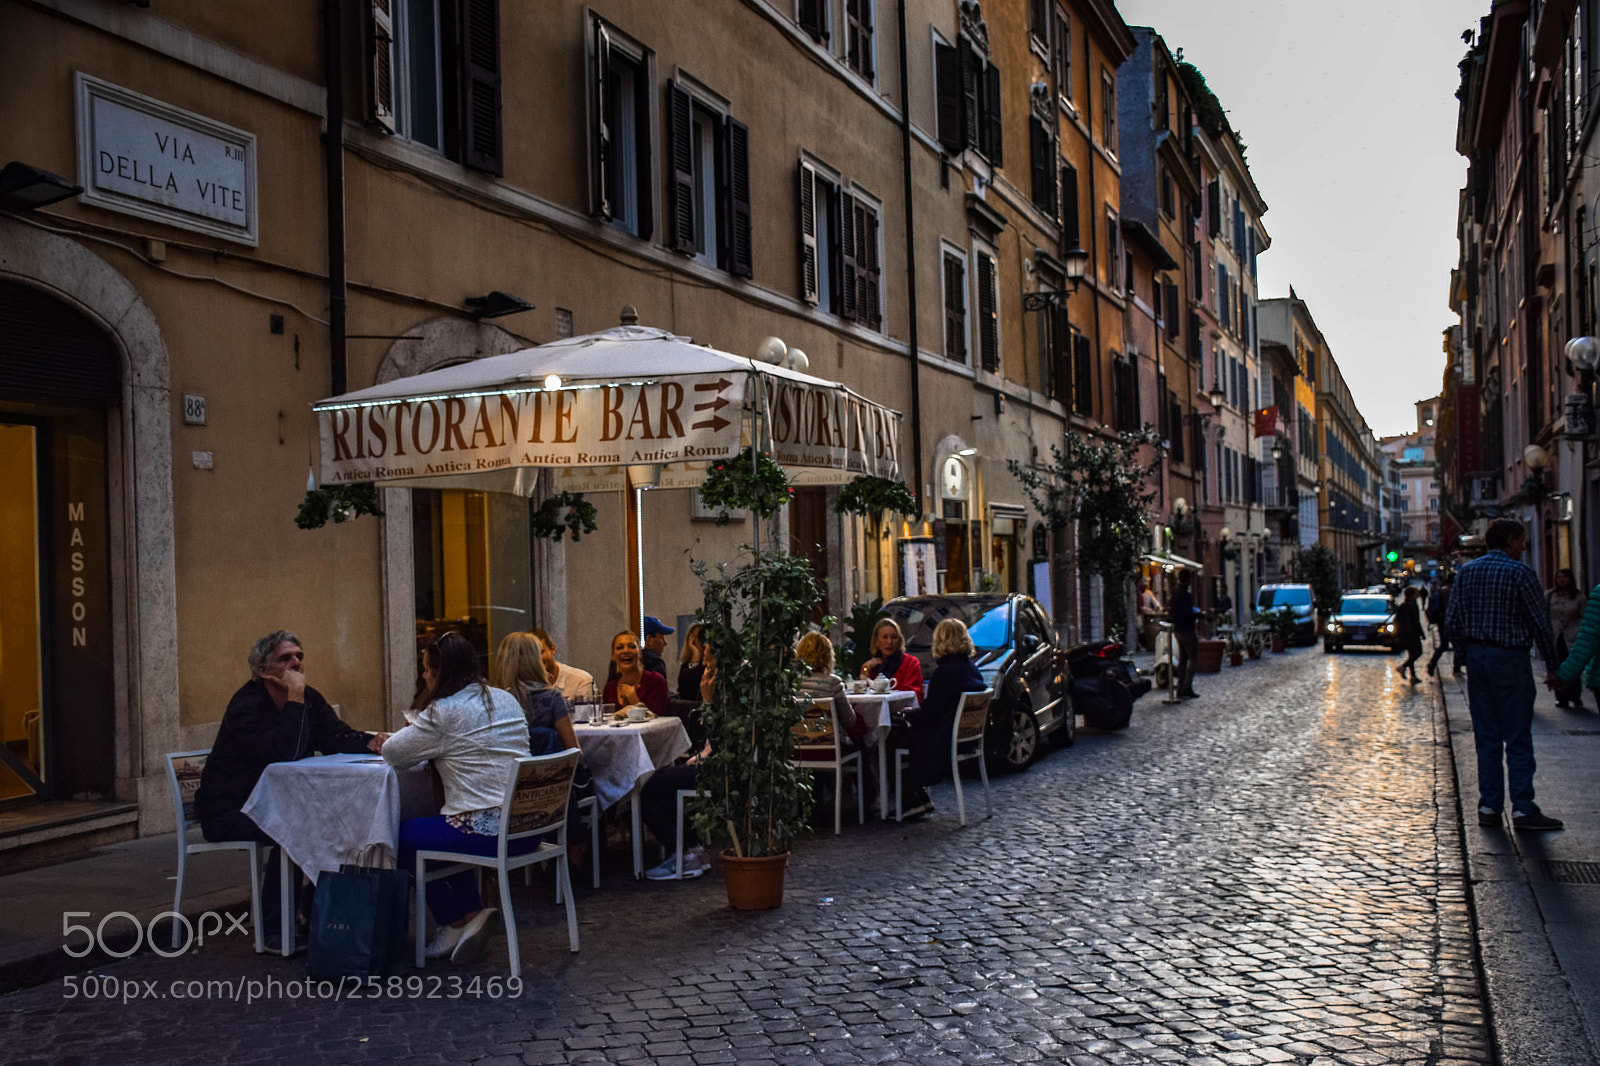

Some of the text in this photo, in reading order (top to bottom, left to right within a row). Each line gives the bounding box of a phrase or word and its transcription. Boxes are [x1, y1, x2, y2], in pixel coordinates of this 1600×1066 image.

[155, 132, 196, 165] VIA
[100, 151, 244, 212] DELLA VITE
[332, 381, 686, 462] RISTORANTE BAR
[332, 445, 731, 481] Antica Roma Antica Roma Antica Roma Antica Roma
[68, 502, 87, 646] MASSON
